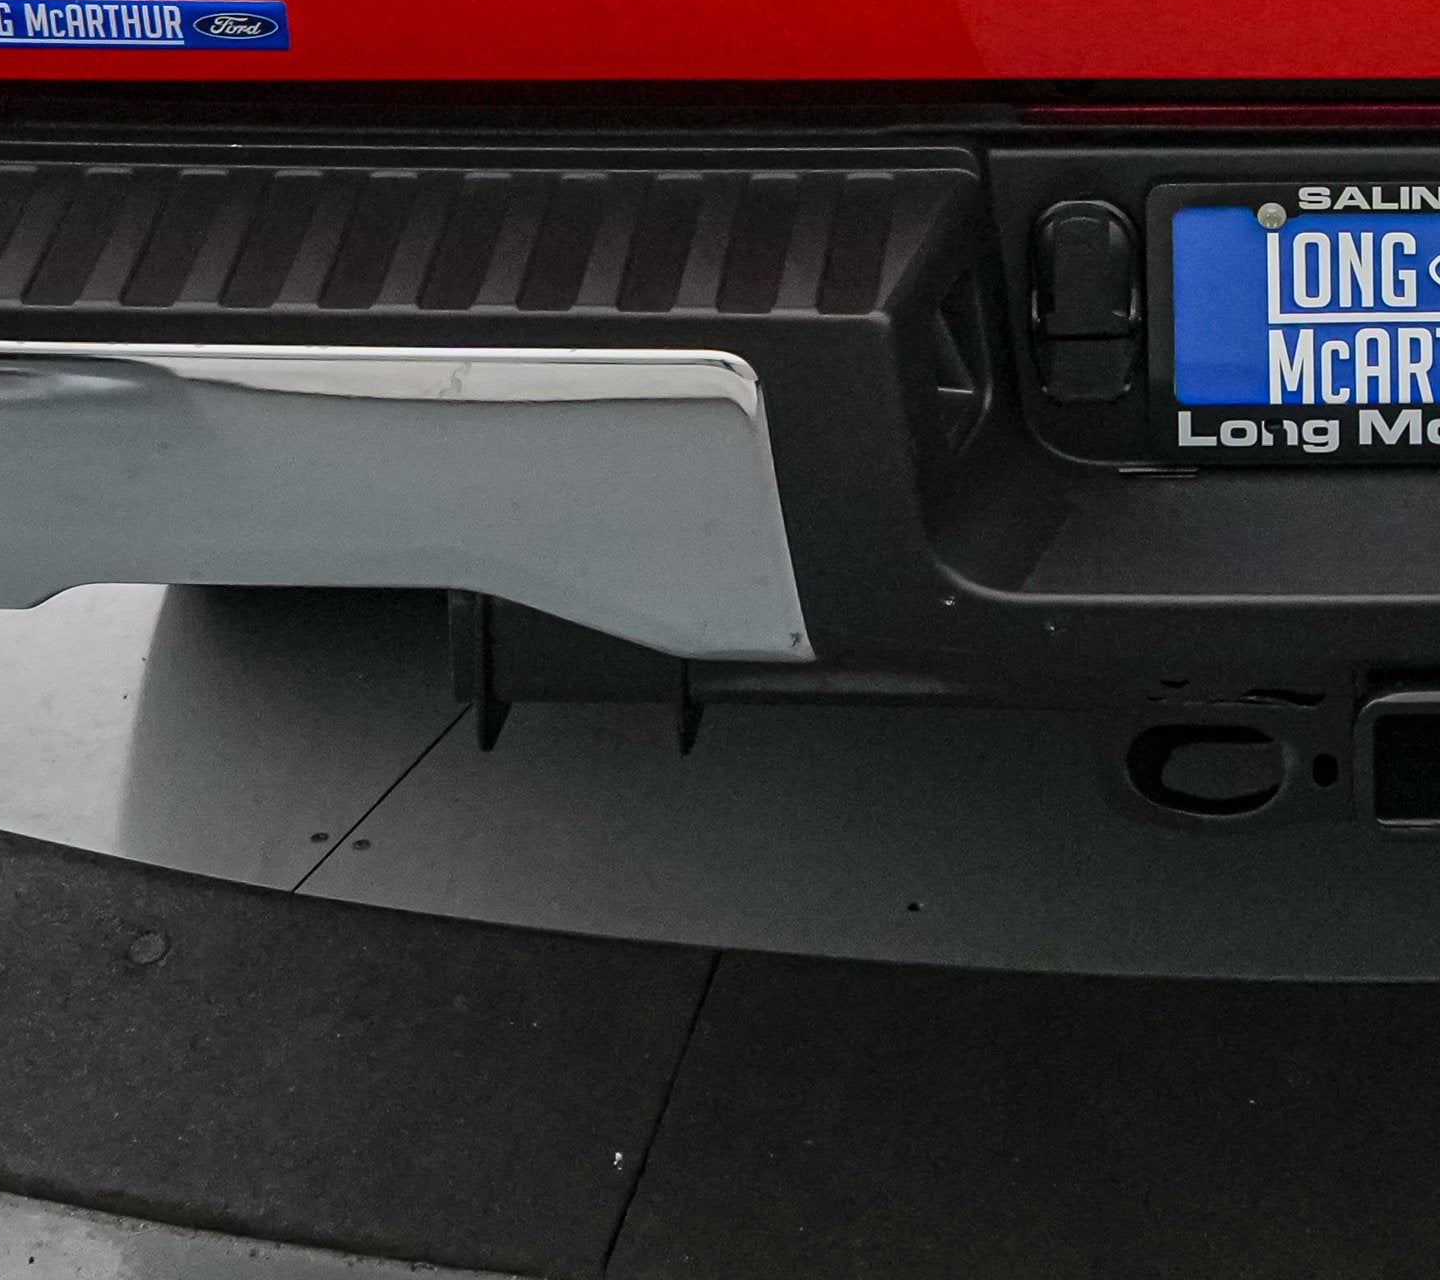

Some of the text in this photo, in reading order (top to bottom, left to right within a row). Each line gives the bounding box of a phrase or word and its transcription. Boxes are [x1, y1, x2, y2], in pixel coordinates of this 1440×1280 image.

[23, 3, 184, 39] McARTHUR
[209, 15, 262, 35] Ford
[1267, 231, 1417, 323] LONG
[1177, 409, 1340, 453] Long
